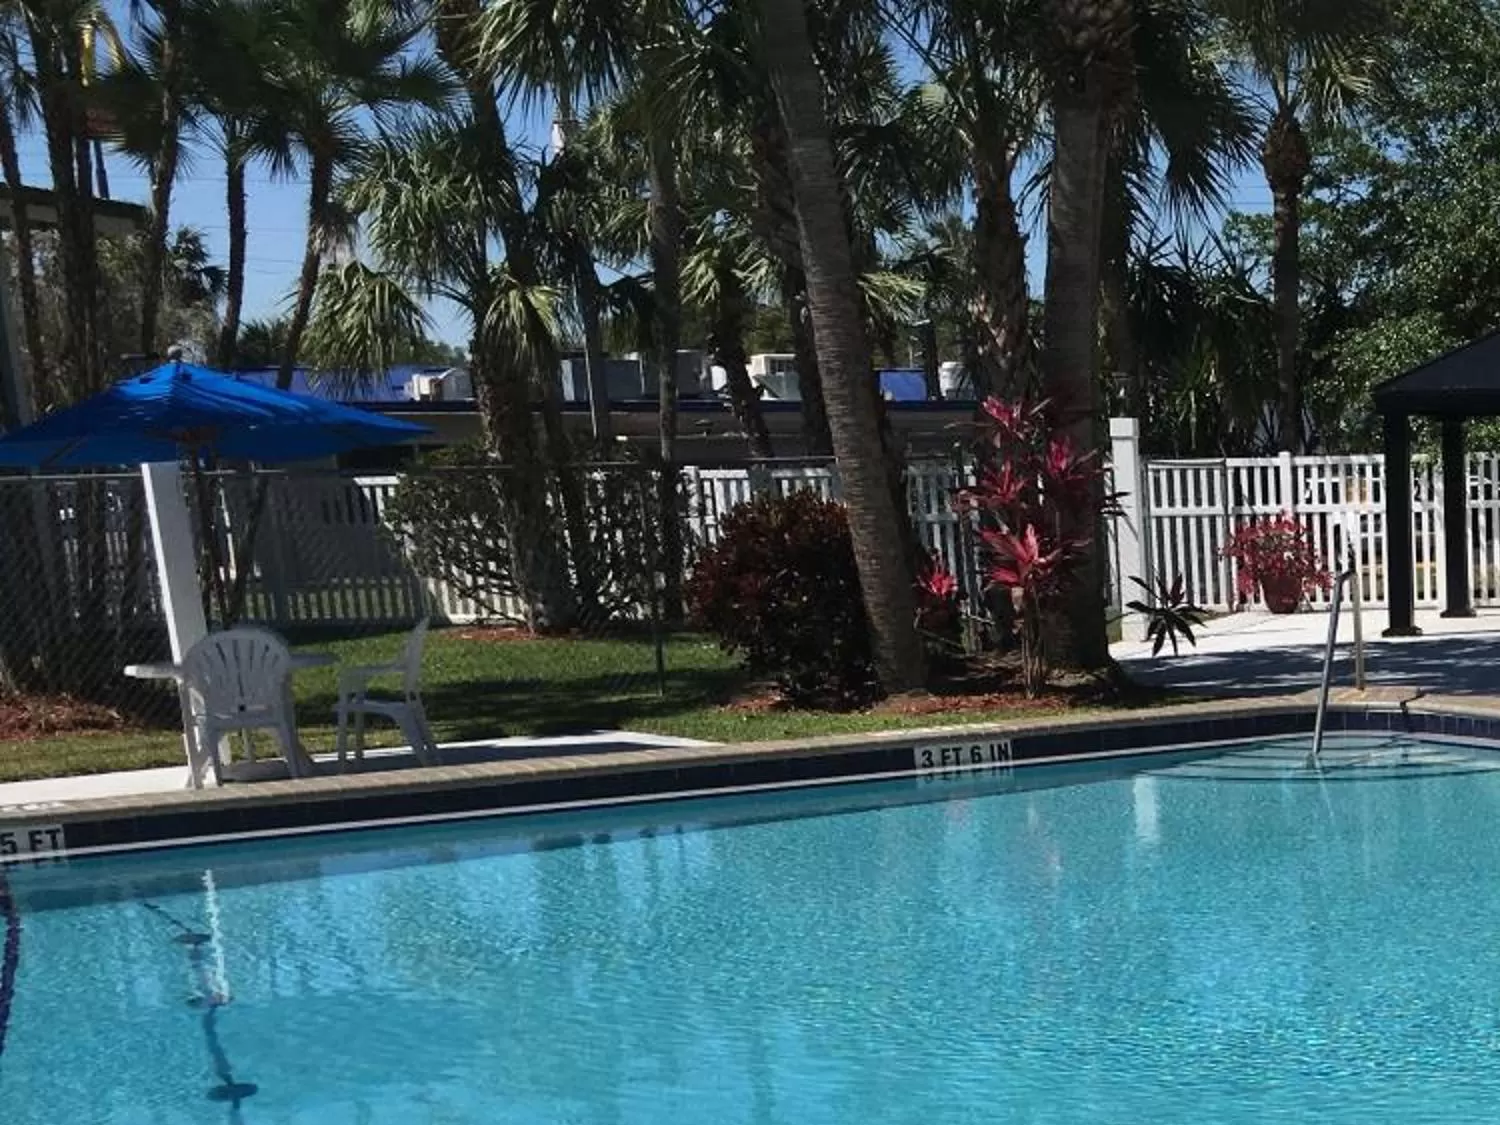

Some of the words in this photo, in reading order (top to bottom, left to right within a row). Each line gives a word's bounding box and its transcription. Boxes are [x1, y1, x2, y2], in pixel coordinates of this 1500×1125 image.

[921, 749, 934, 768] 3
[941, 747, 962, 767] FT
[970, 745, 982, 764] 6
[990, 742, 1009, 762] IN
[0, 831, 18, 854] 5
[28, 828, 61, 851] FT
